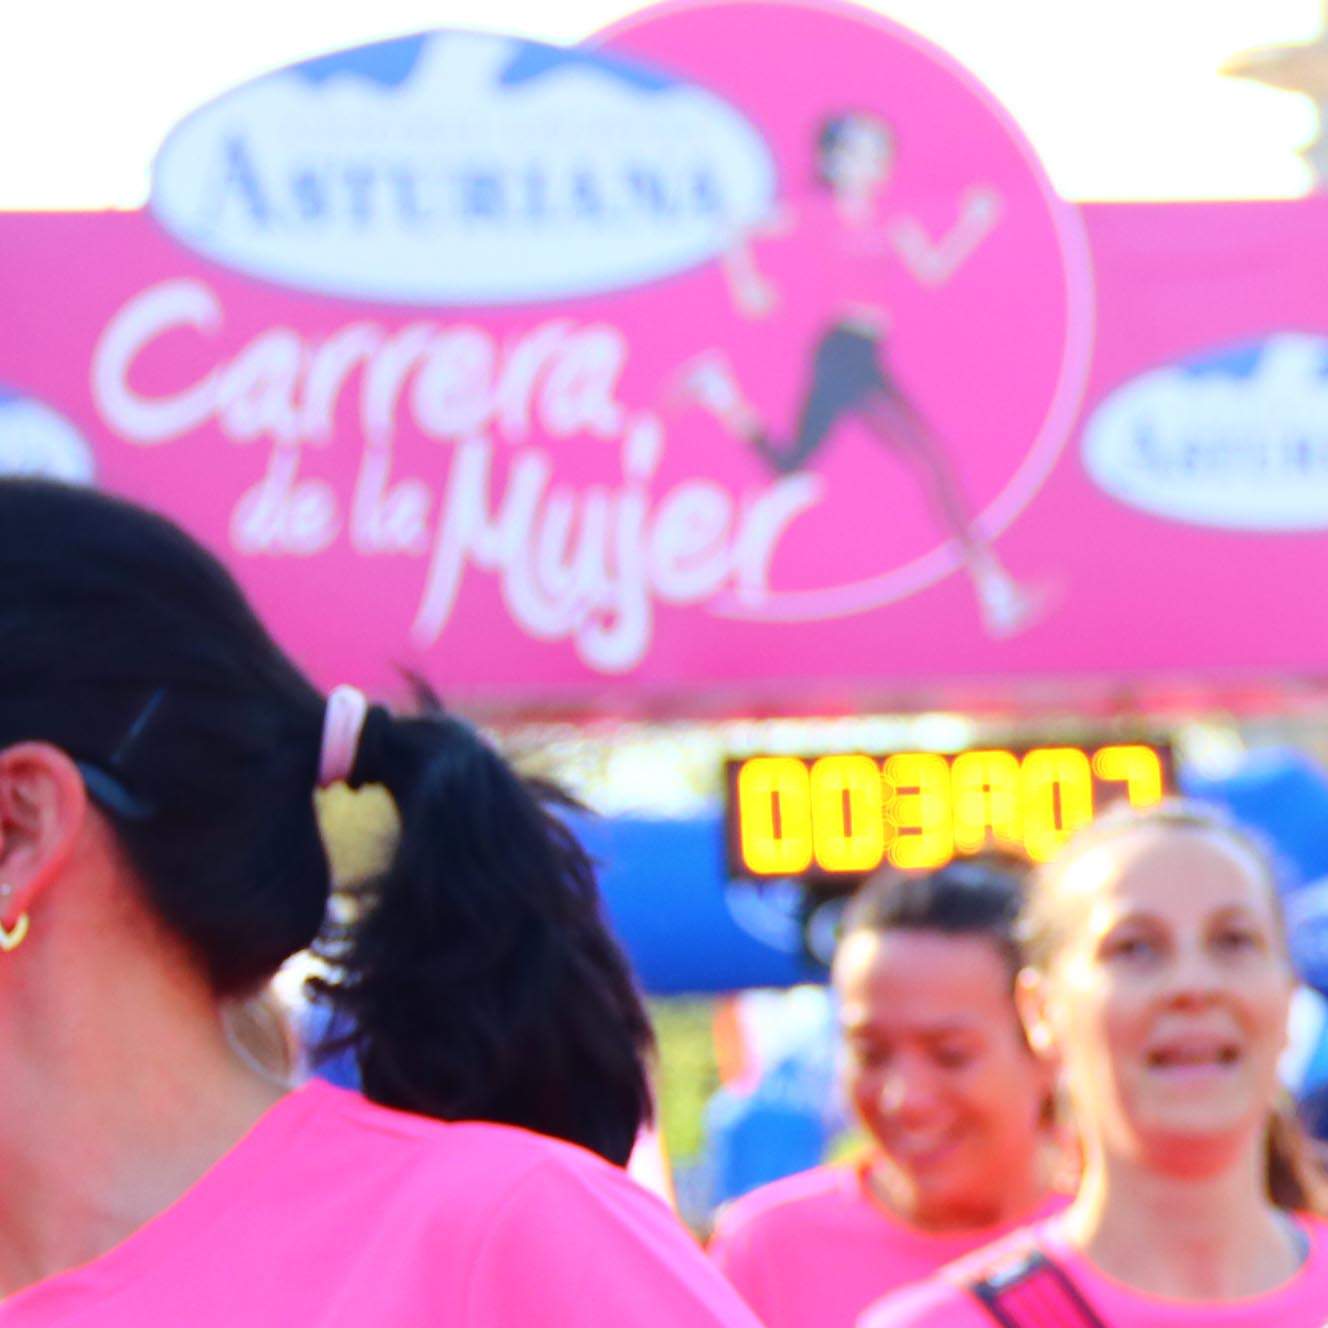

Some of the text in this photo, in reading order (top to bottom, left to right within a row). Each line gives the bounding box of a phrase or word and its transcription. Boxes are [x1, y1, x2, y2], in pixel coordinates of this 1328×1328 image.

[92, 279, 624, 444] Carrera
[232, 412, 824, 673] de la Mujer
